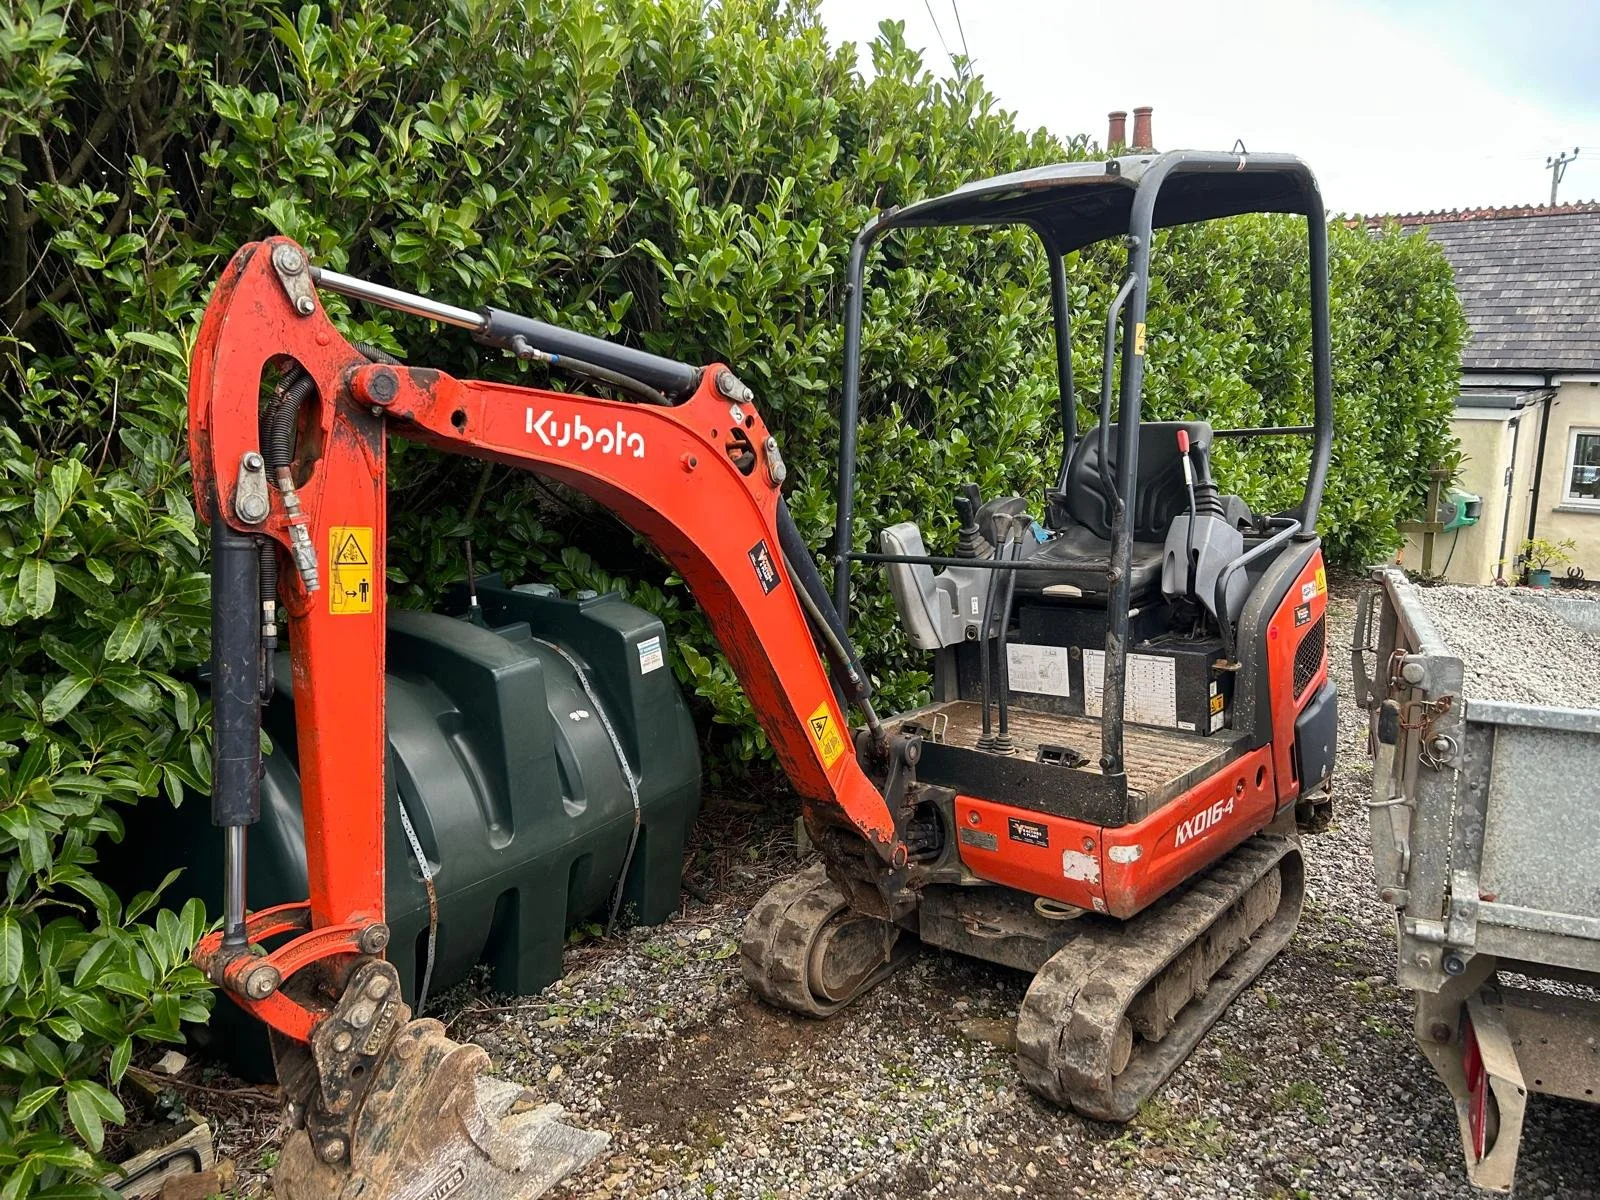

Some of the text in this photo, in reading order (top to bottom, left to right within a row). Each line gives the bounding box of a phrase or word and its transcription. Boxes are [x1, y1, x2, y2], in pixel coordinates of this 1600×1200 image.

[525, 407, 645, 458] Kubota
[1174, 796, 1234, 848] KX016-4
[426, 1170, 463, 1200] HITES
